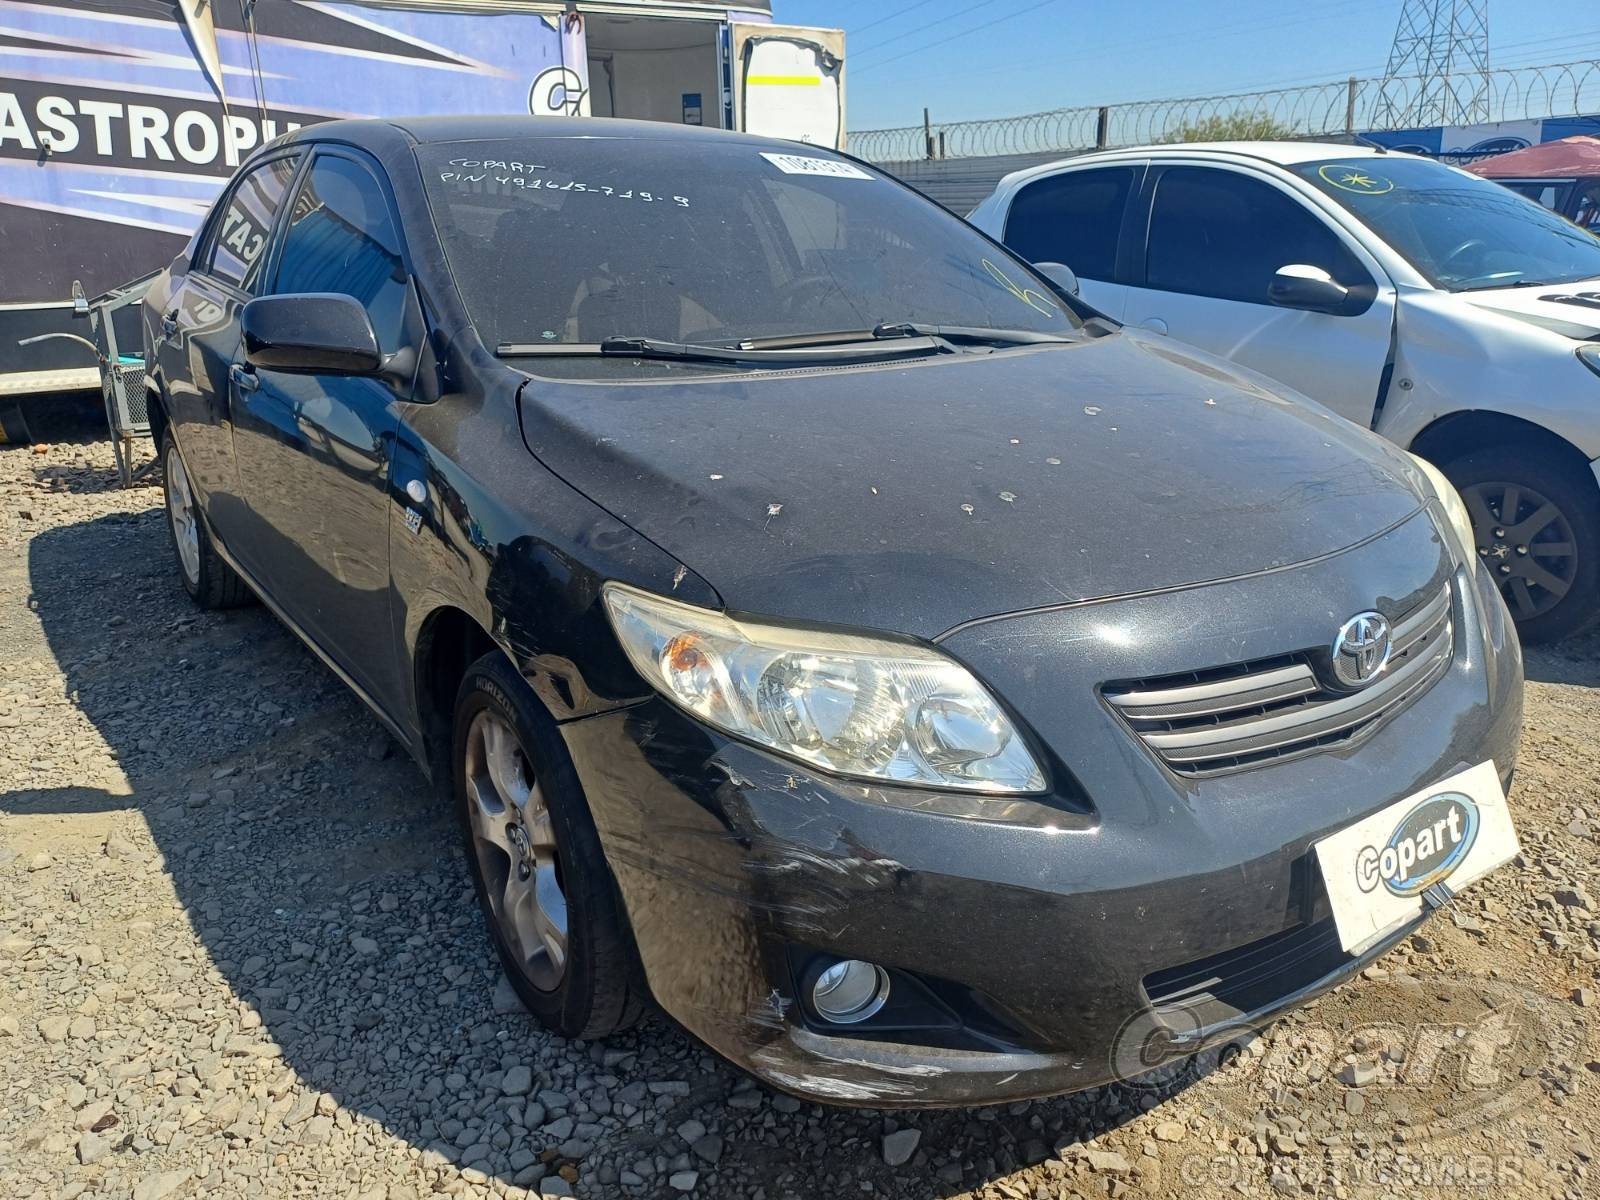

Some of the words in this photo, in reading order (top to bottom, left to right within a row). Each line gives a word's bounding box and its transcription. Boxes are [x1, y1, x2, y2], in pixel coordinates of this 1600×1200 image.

[440, 172, 486, 183] PIN
[449, 158, 546, 174] COPART
[475, 676, 518, 723] HORIZON
[1356, 805, 1462, 893] Copart
